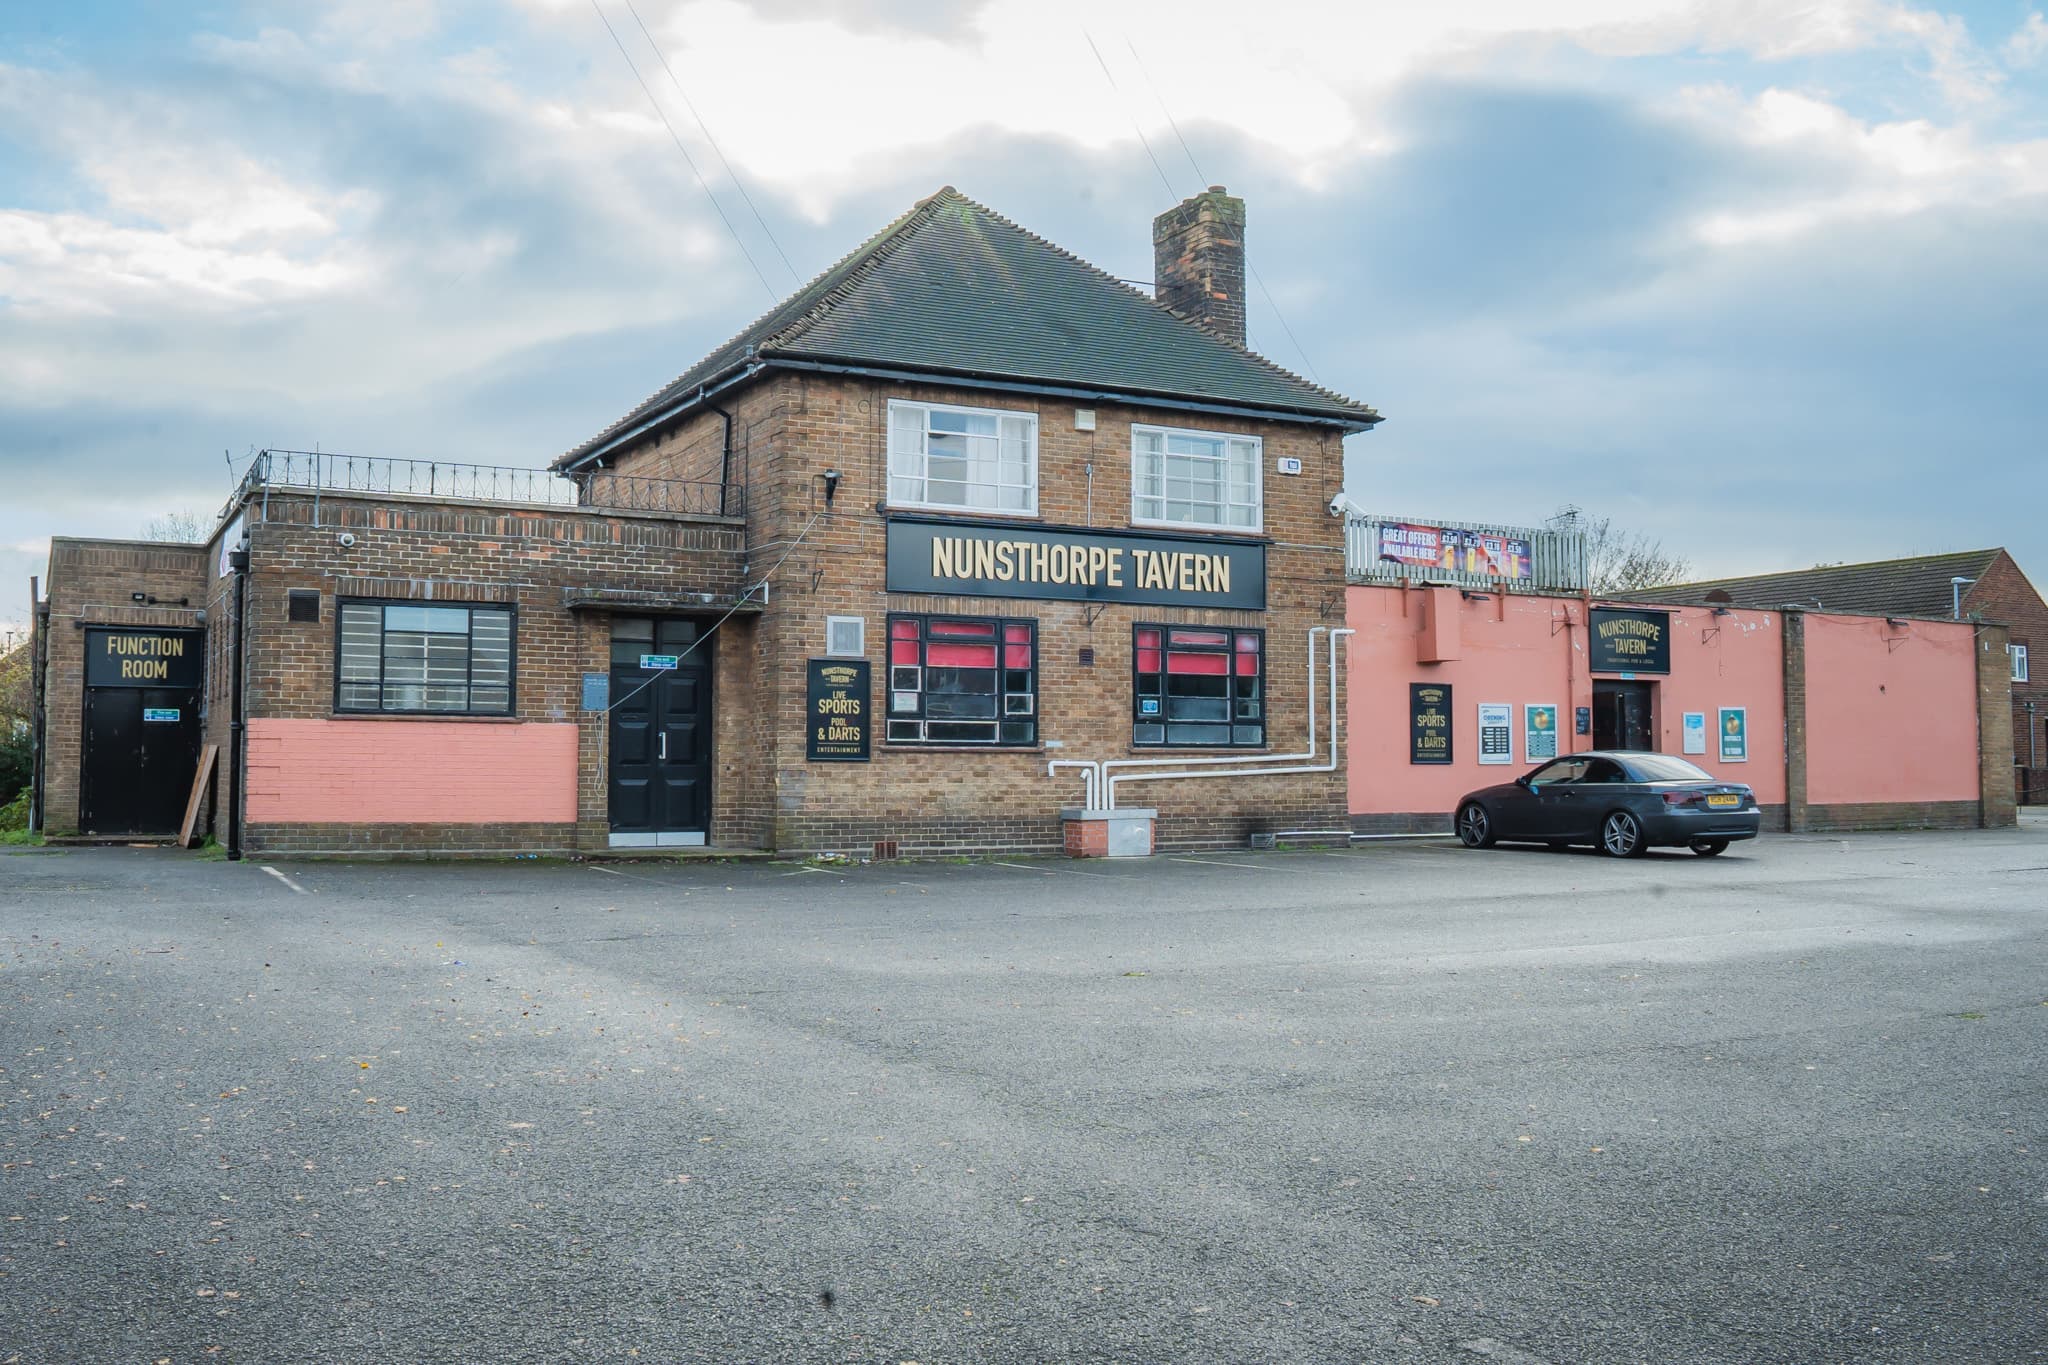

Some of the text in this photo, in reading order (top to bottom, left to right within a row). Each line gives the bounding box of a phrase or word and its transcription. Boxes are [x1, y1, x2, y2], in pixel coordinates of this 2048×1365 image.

[1382, 528, 1437, 547] GREAT OFFERS
[1383, 543, 1437, 561] AVAILABLE HERE
[932, 536, 1230, 593] NUNSTHORPE TAVERN
[1598, 619, 1661, 641] NUNSTHORPE
[107, 635, 184, 657] FUNCTION
[1614, 638, 1647, 655] TAVERN
[122, 659, 168, 679] ROOM
[821, 666, 858, 677] NUNSTHORPE
[830, 675, 850, 683] TAVERN
[832, 690, 847, 700] LIVE
[818, 699, 860, 715] SPORTS
[831, 718, 847, 727] POOL
[1417, 715, 1446, 727] SPORTS
[817, 727, 860, 742] & DARTS
[1417, 737, 1446, 748] & DARTS
